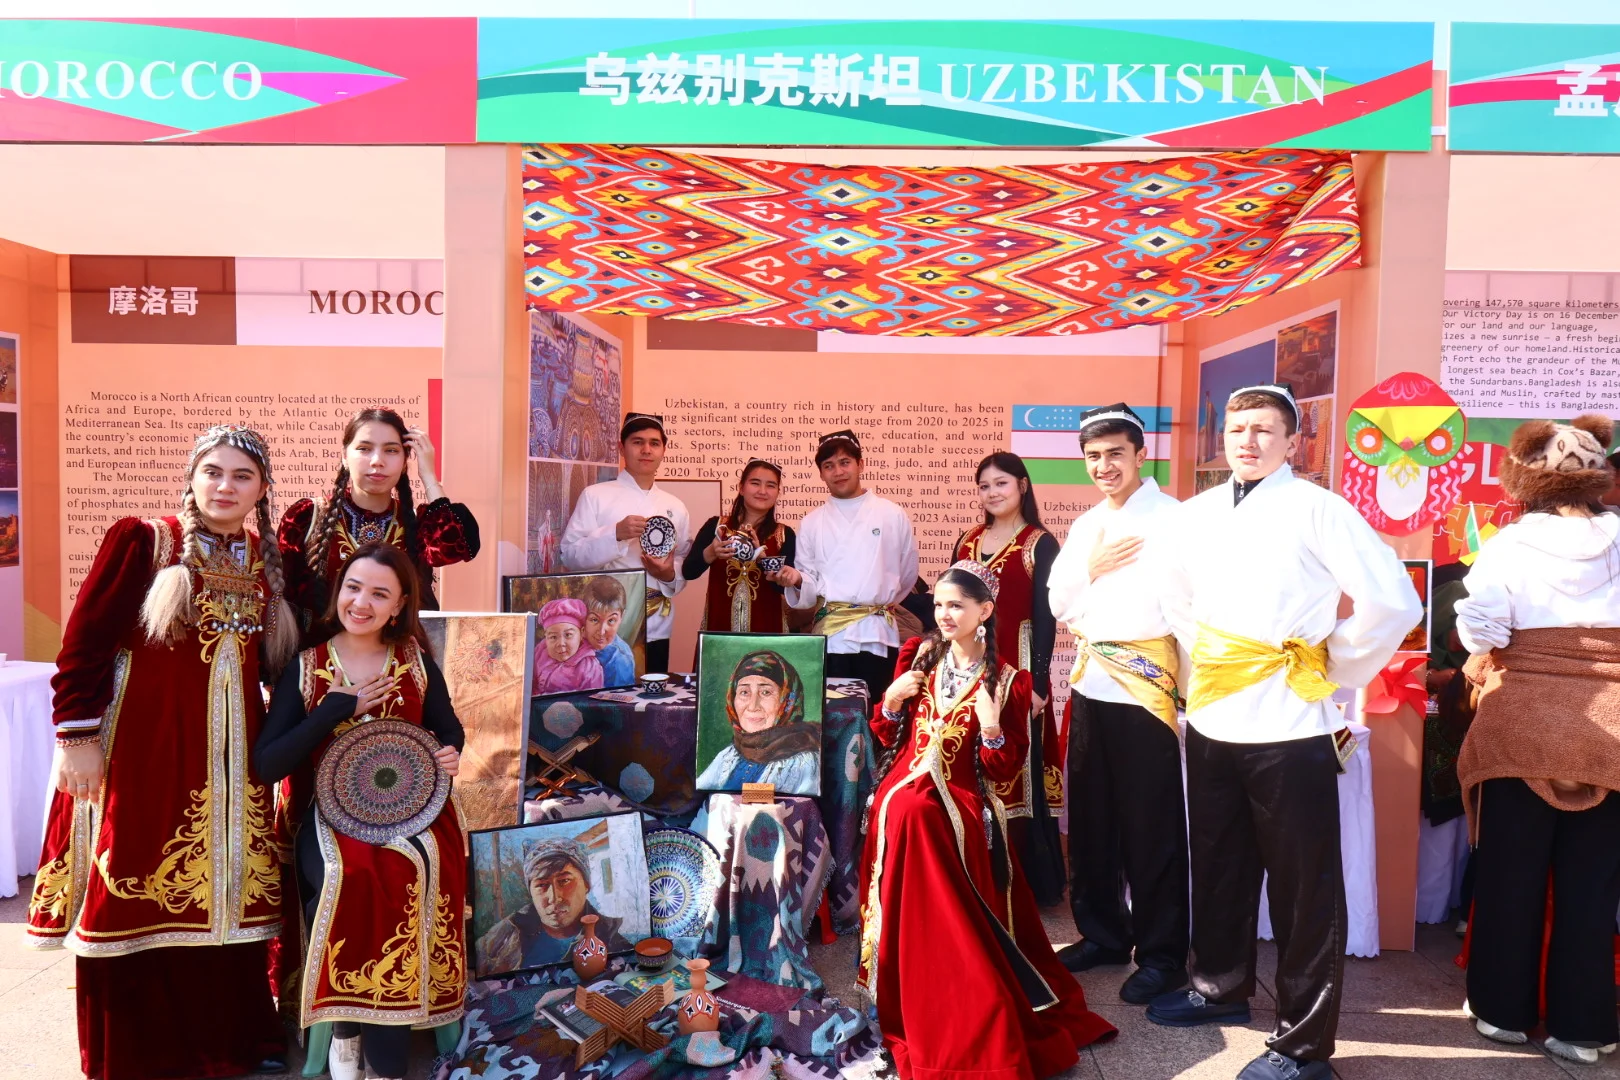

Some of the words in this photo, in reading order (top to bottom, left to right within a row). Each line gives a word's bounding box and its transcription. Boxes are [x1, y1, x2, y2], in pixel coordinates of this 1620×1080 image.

[579, 51, 924, 107] 乌兹别克斯坦
[941, 64, 1327, 106] UZBEKISTAN
[1554, 63, 1620, 118] 孟
[108, 285, 198, 316] 摩洛哥
[308, 289, 444, 316] MOROC
[1443, 300, 1480, 308] overing
[1486, 300, 1523, 308] 147,570
[1529, 301, 1560, 309] square
[1566, 300, 1618, 308] kilometers
[1464, 310, 1500, 319] Victory
[1506, 311, 1522, 320] Day
[1482, 321, 1503, 329] land
[1552, 322, 1597, 332] language,
[1502, 333, 1539, 341] sunrise
[1566, 334, 1592, 342] fresh
[1441, 345, 1483, 353] greenery
[1488, 344, 1499, 352] of
[1527, 357, 1569, 365] grandeur
[1591, 357, 1607, 365] the
[1448, 366, 1484, 375] longest
[1470, 378, 1581, 388] Sundarbans.Bangladesh
[91, 392, 136, 401] Morocco
[141, 392, 148, 401] is
[160, 393, 190, 401] North
[193, 393, 232, 402] African
[235, 395, 274, 405] country
[278, 394, 315, 403] located
[332, 395, 347, 404] the
[351, 395, 405, 404] crossroads
[409, 395, 421, 404] of
[1501, 389, 1536, 398] Muslin,
[1544, 390, 1582, 398] crafted
[1586, 391, 1596, 400] by
[65, 405, 99, 414] Africa
[107, 405, 126, 414] and
[134, 406, 175, 417] Europe,
[184, 406, 231, 416] bordered
[239, 407, 251, 418] by
[259, 407, 275, 416] the
[283, 408, 327, 417] Atlantic
[403, 410, 419, 418] the
[665, 399, 727, 410] Uzbekistan,
[747, 402, 787, 412] country
[794, 401, 814, 410] rich
[821, 401, 831, 410] in
[838, 402, 874, 413] history
[881, 403, 900, 412] and
[907, 403, 948, 413] culture,
[955, 403, 972, 412] has
[979, 404, 1003, 413] been
[1561, 402, 1618, 411] Bangladesh.
[66, 418, 140, 428] Mediterranean
[145, 419, 166, 428] Sea.
[171, 420, 183, 429] Its
[277, 421, 305, 430] while
[682, 413, 737, 424] significant
[742, 414, 776, 423] strides
[799, 415, 814, 424] the
[820, 416, 850, 425] world
[855, 418, 882, 427] stage
[887, 416, 912, 426] from
[917, 417, 943, 426] 2020
[962, 417, 988, 426] 2025
[994, 418, 1003, 427] in
[66, 432, 81, 440] the
[283, 435, 294, 444] its
[300, 435, 337, 444] ancient
[684, 428, 725, 438] sectors,
[733, 428, 783, 440] including
[882, 430, 937, 441] education,
[946, 431, 964, 440] and
[972, 432, 1003, 441] world
[66, 445, 110, 456] markets,
[114, 446, 132, 455] and
[136, 446, 156, 455] rich
[289, 449, 317, 458] Arab,
[691, 441, 730, 452] Sports:
[738, 442, 758, 451] The
[766, 442, 801, 451] nation
[893, 444, 934, 453] notable
[66, 459, 84, 468] and
[88, 459, 136, 470] European
[288, 462, 327, 471] cultural
[663, 455, 705, 463] national
[712, 456, 747, 465] sports,
[894, 458, 922, 469] judo,
[928, 459, 947, 468] and
[953, 459, 978, 468] athle
[93, 472, 112, 481] The
[117, 472, 168, 482] Moroccan
[281, 475, 304, 484] with
[309, 475, 325, 485] key
[664, 468, 690, 476] 2020
[696, 468, 729, 479] Tokyo
[859, 472, 900, 480] athletes
[907, 472, 950, 484] winning
[67, 487, 109, 496] tourism,
[113, 486, 172, 497] agriculture,
[876, 485, 913, 497] boxing
[920, 486, 939, 495] and
[947, 487, 979, 496] wrestl
[67, 498, 79, 507] of
[81, 499, 139, 510] phosphates
[142, 500, 160, 509] and
[165, 500, 181, 509] has
[776, 497, 825, 510] eputation
[956, 500, 965, 509] in
[1044, 502, 1096, 511] Uzbekist
[68, 512, 107, 521] tourism
[913, 513, 938, 522] 2023
[942, 514, 972, 523] Asian
[69, 525, 89, 535] Fes,
